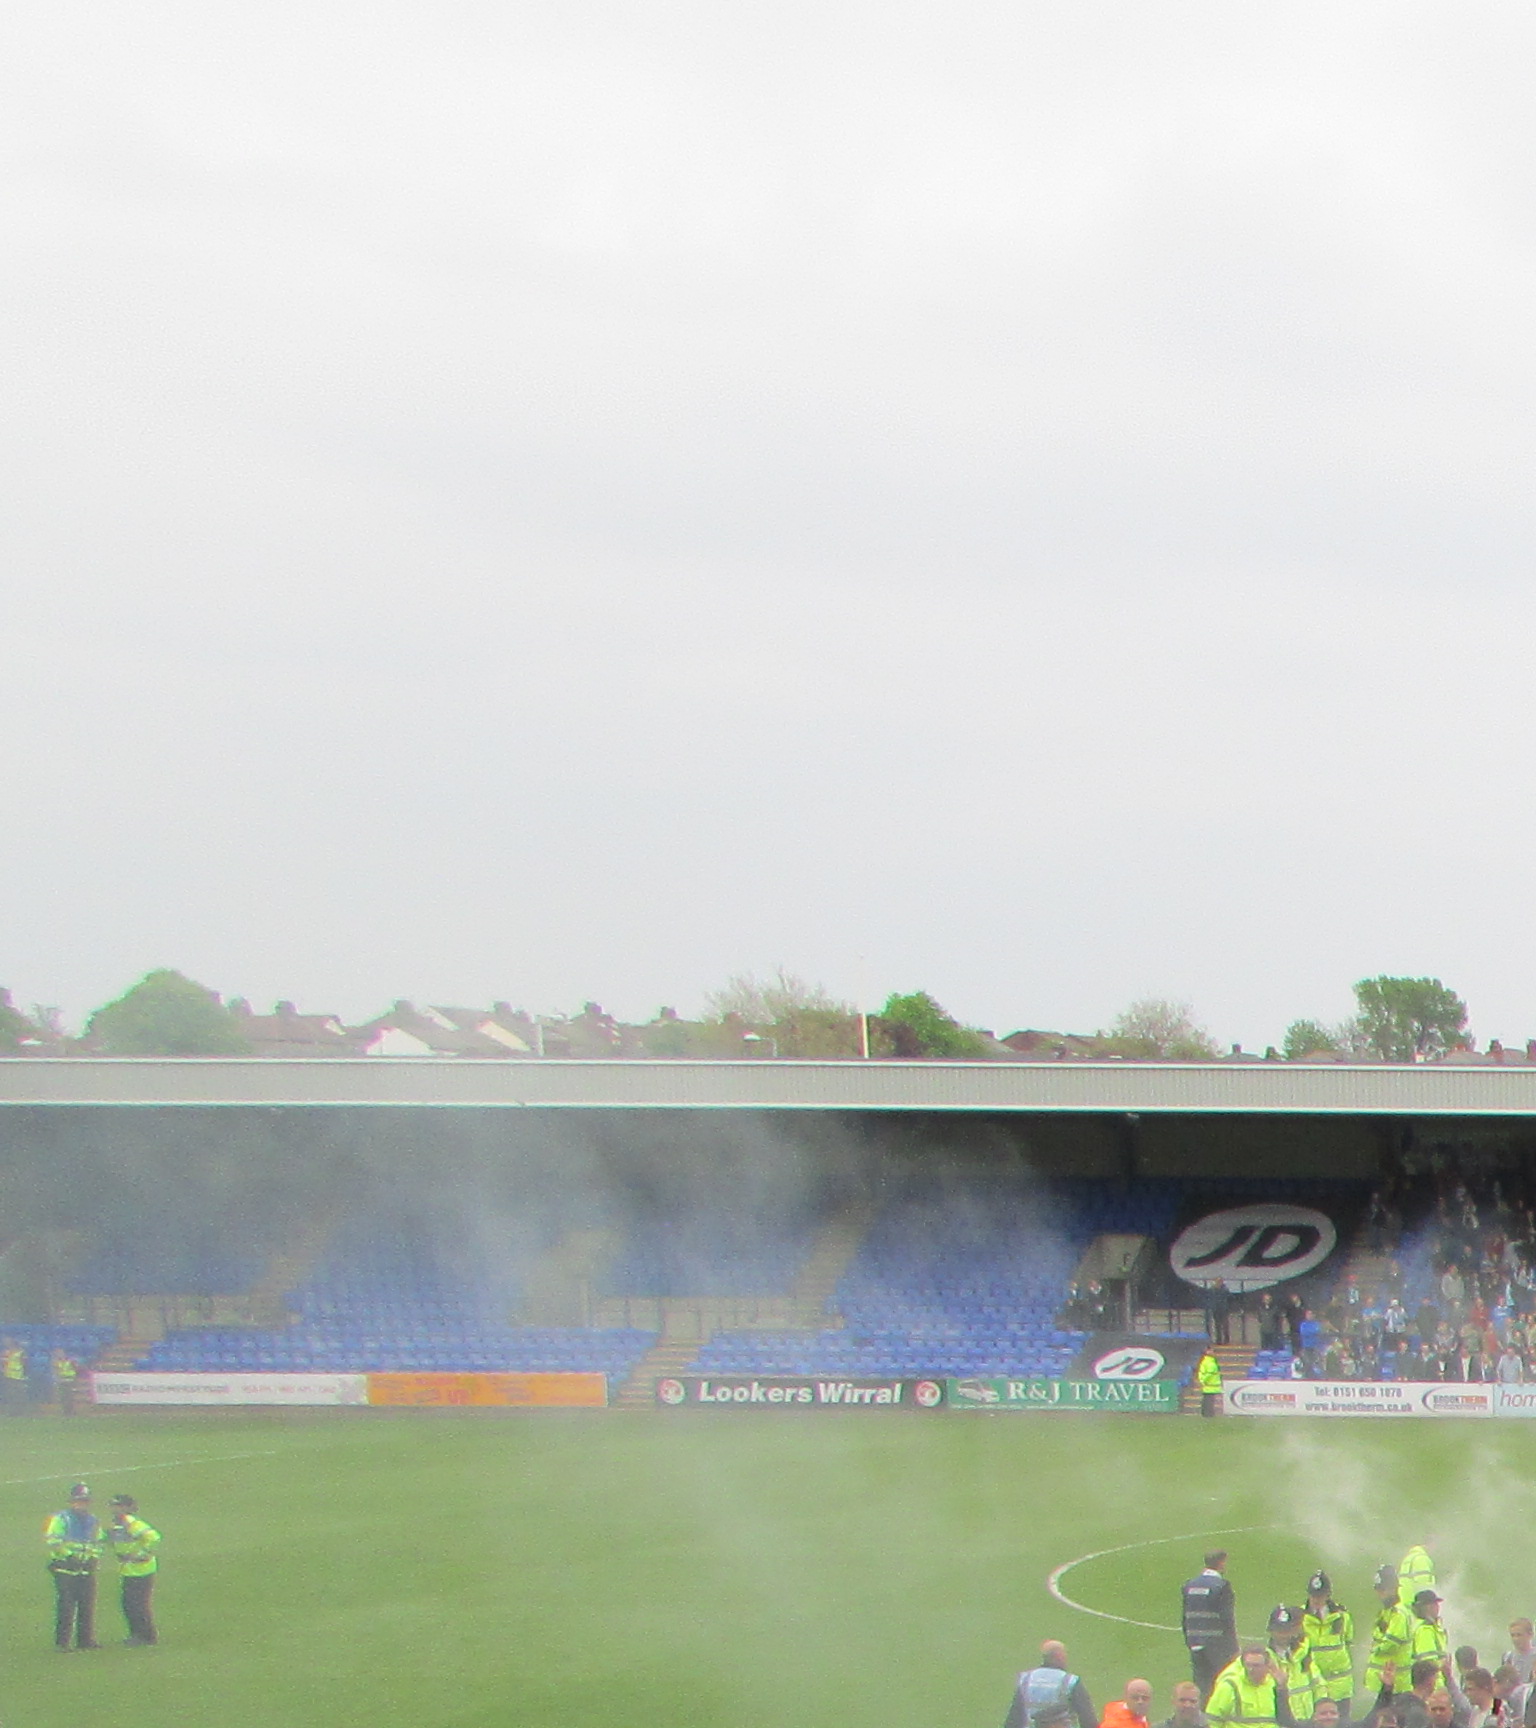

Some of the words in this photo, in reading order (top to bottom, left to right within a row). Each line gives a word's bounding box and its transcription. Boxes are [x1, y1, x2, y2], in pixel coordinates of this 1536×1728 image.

[699, 1381, 813, 1404] Lookers
[817, 1382, 903, 1404] Wirral
[1007, 1381, 1060, 1404] R&J
[1069, 1382, 1170, 1402] TRAVEL
[1333, 1386, 1356, 1398] 0151
